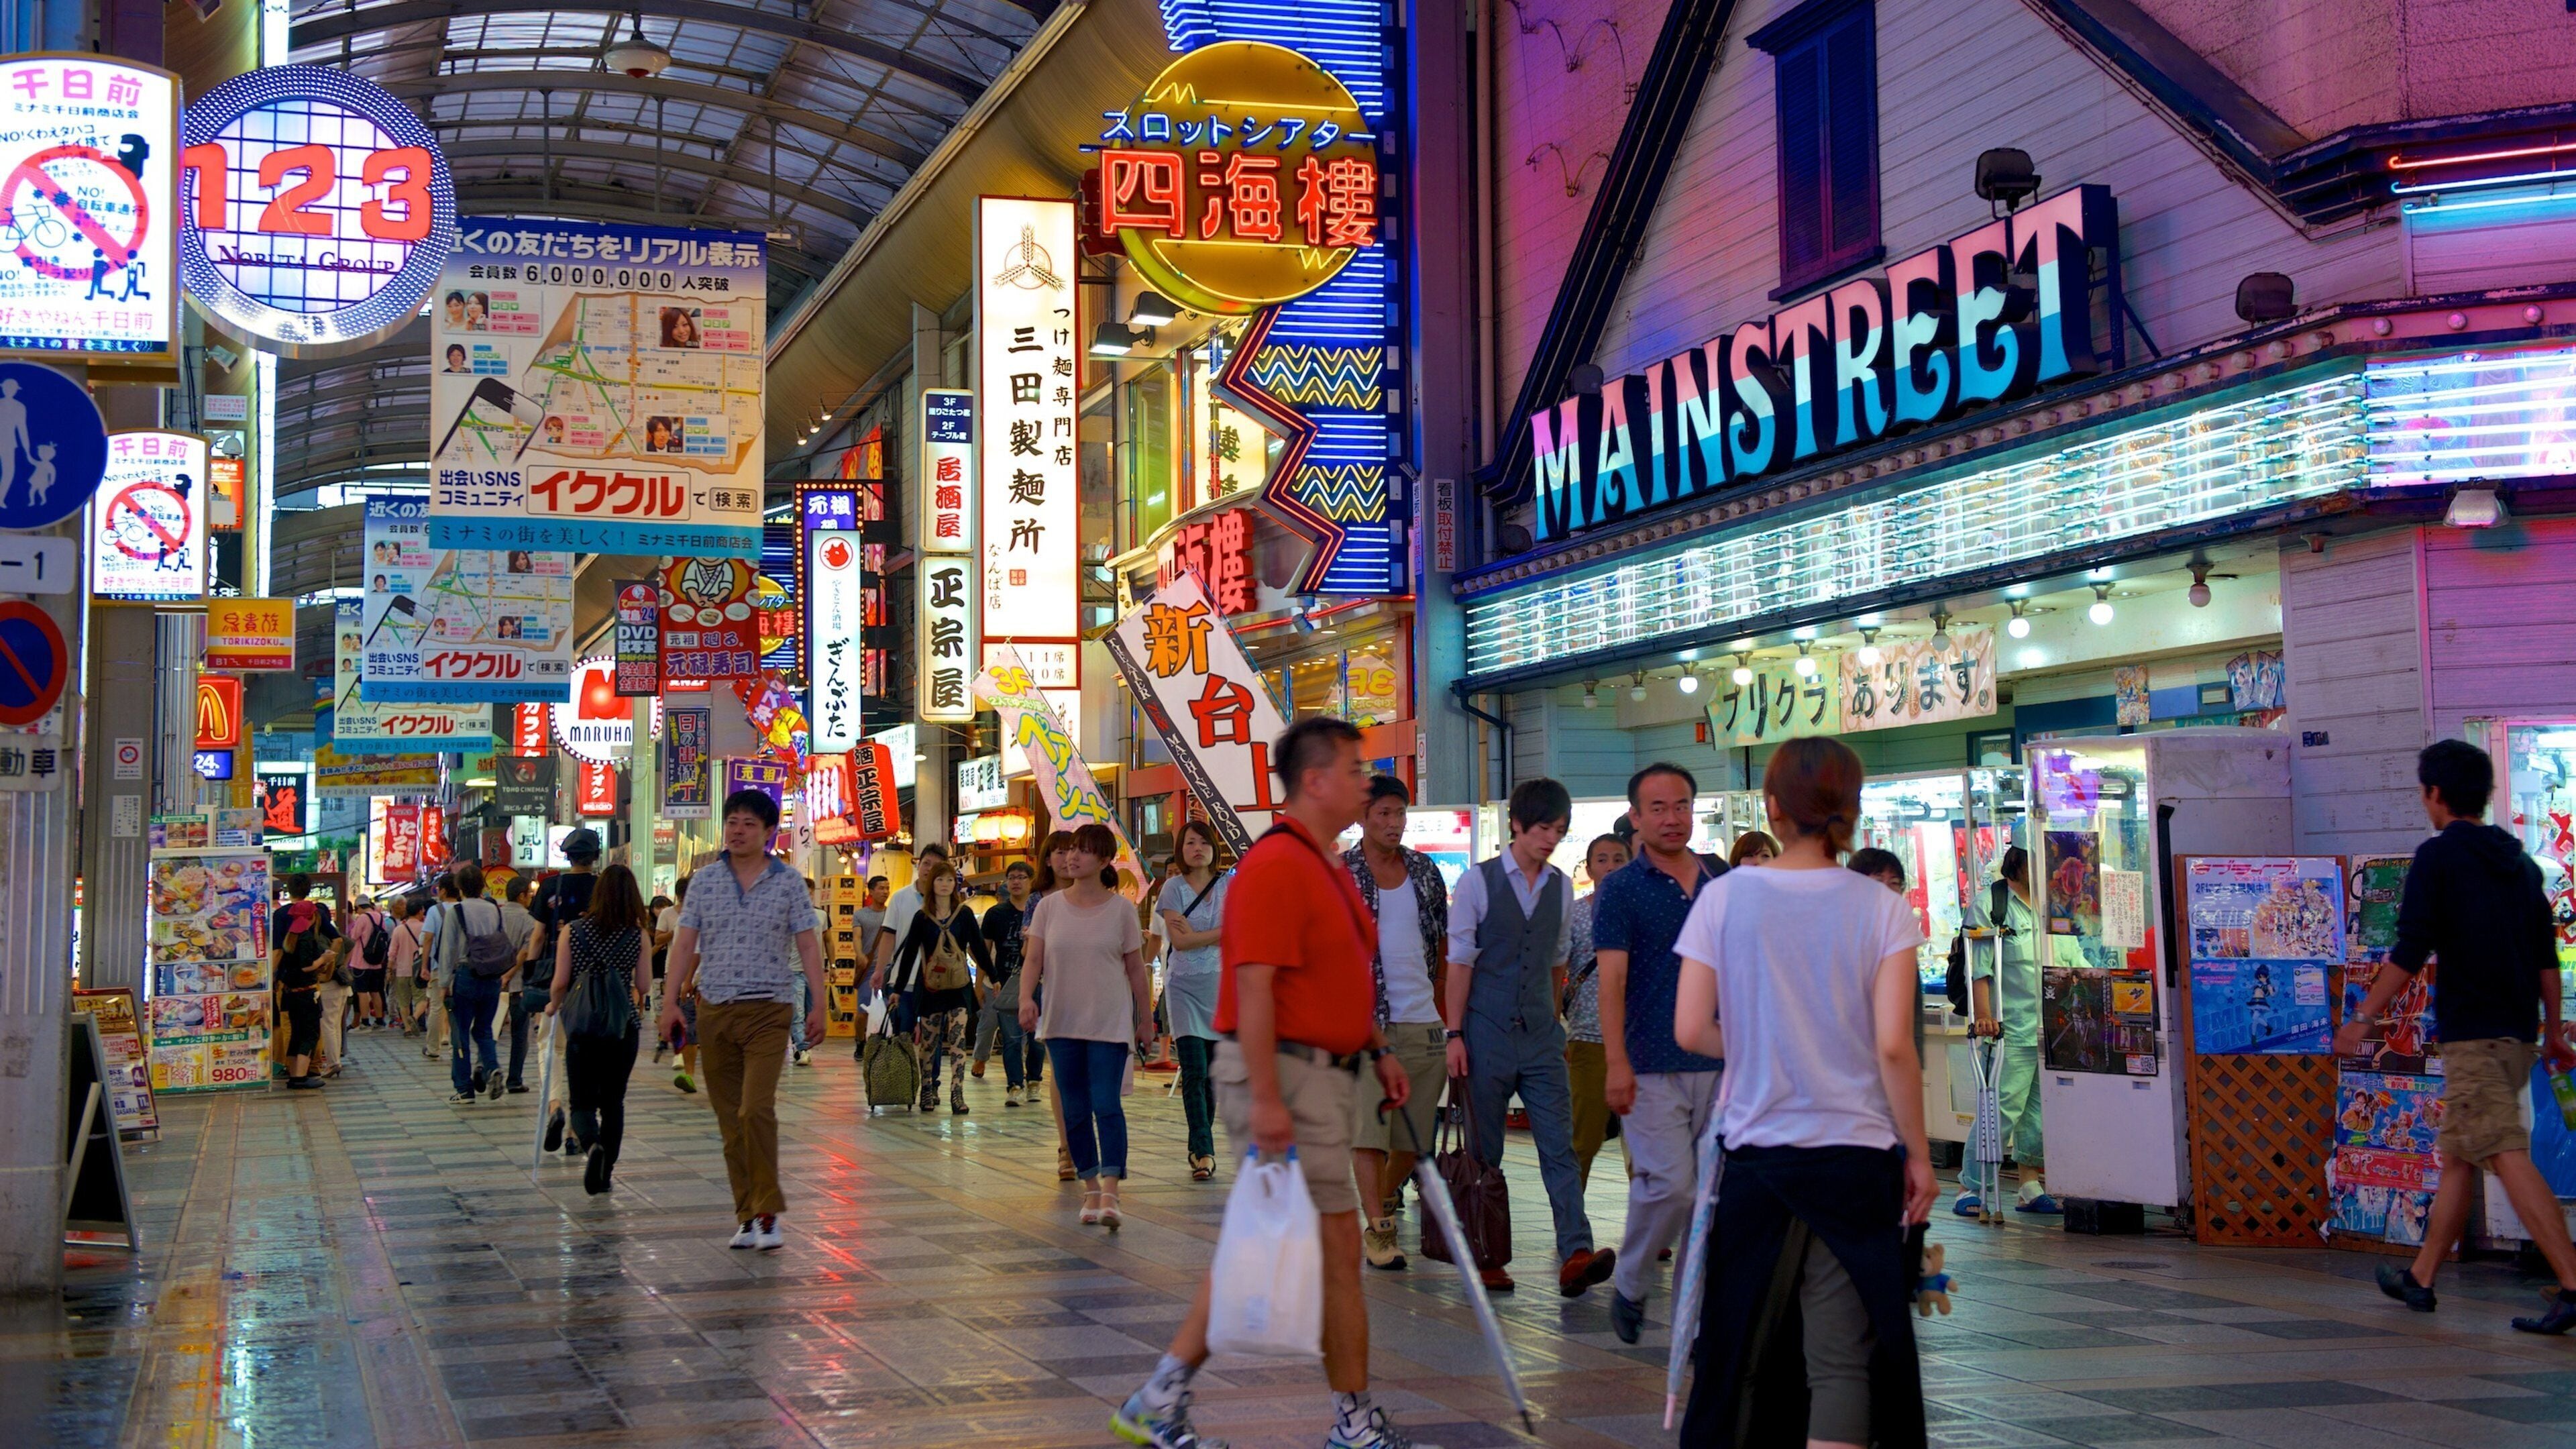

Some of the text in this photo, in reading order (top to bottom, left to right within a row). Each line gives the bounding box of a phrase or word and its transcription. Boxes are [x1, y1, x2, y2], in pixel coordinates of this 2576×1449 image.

[12, 68, 143, 107] 千日前
[14, 102, 140, 119] ミナミ千日前商店会
[1102, 111, 1376, 148] スロットシアター
[77, 185, 105, 197] NO!
[183, 142, 431, 241] 123
[77, 199, 144, 217] 自転車通行
[319, 252, 395, 273] GROUP
[470, 264, 730, 292] 会員数 6,000,000 人突破
[1530, 184, 2088, 542] MAINSTREET
[1052, 307, 1073, 467] つけ麺専門店
[943, 397, 957, 406] 3F
[942, 421, 955, 430] 2F
[931, 431, 967, 440] テーブル席
[1008, 327, 1046, 556] 三田製麺所
[114, 437, 189, 458] 千日前
[439, 470, 521, 488] 出会いSNS
[439, 489, 525, 506] コミュニティ
[531, 470, 684, 517] イククル
[692, 492, 706, 506] で
[715, 492, 752, 509] 検索
[935, 456, 963, 538] 居酒屋
[808, 495, 851, 516] 元祖
[388, 524, 419, 533] 会員数
[1437, 482, 1454, 569] 看板取付禁止
[638, 533, 753, 549] ミナミ千日前商店会
[987, 542, 1002, 610] なんば店
[337, 603, 362, 616] 近く
[222, 612, 279, 633] 鳥貴族
[221, 637, 280, 646] TORIKIZOKU
[619, 626, 657, 640] DVD
[669, 634, 695, 645] 元祖
[930, 567, 965, 708] 正宗屋
[618, 640, 657, 653] 試写室
[368, 653, 419, 663] 出会いSNS
[425, 651, 521, 679] イククル
[526, 662, 534, 672] で
[540, 661, 564, 672] 検索
[665, 651, 755, 677] 元禄寿司
[368, 665, 421, 676] コミュニティ
[619, 662, 657, 677] 完全個室
[619, 678, 656, 692] 全室防音
[825, 636, 850, 738] ぎんぶた
[989, 665, 1034, 696] 3F
[1851, 649, 1989, 720] あります。
[491, 688, 564, 698] ミナミ千日前商店会
[1722, 671, 1828, 739] プリクラ
[338, 716, 377, 725] 出会いSNS
[381, 715, 454, 735] イククル
[1107, 636, 1153, 700] THEATER
[1165, 733, 1215, 800] MACHINE
[1212, 802, 1241, 841] ROAD
[678, 713, 697, 802] 日の出横丁
[268, 776, 297, 787] 千日前
[741, 766, 775, 781] 元祖
[263, 787, 303, 834] 道
[320, 861, 336, 872] 24
[212, 1067, 258, 1082] 980円
